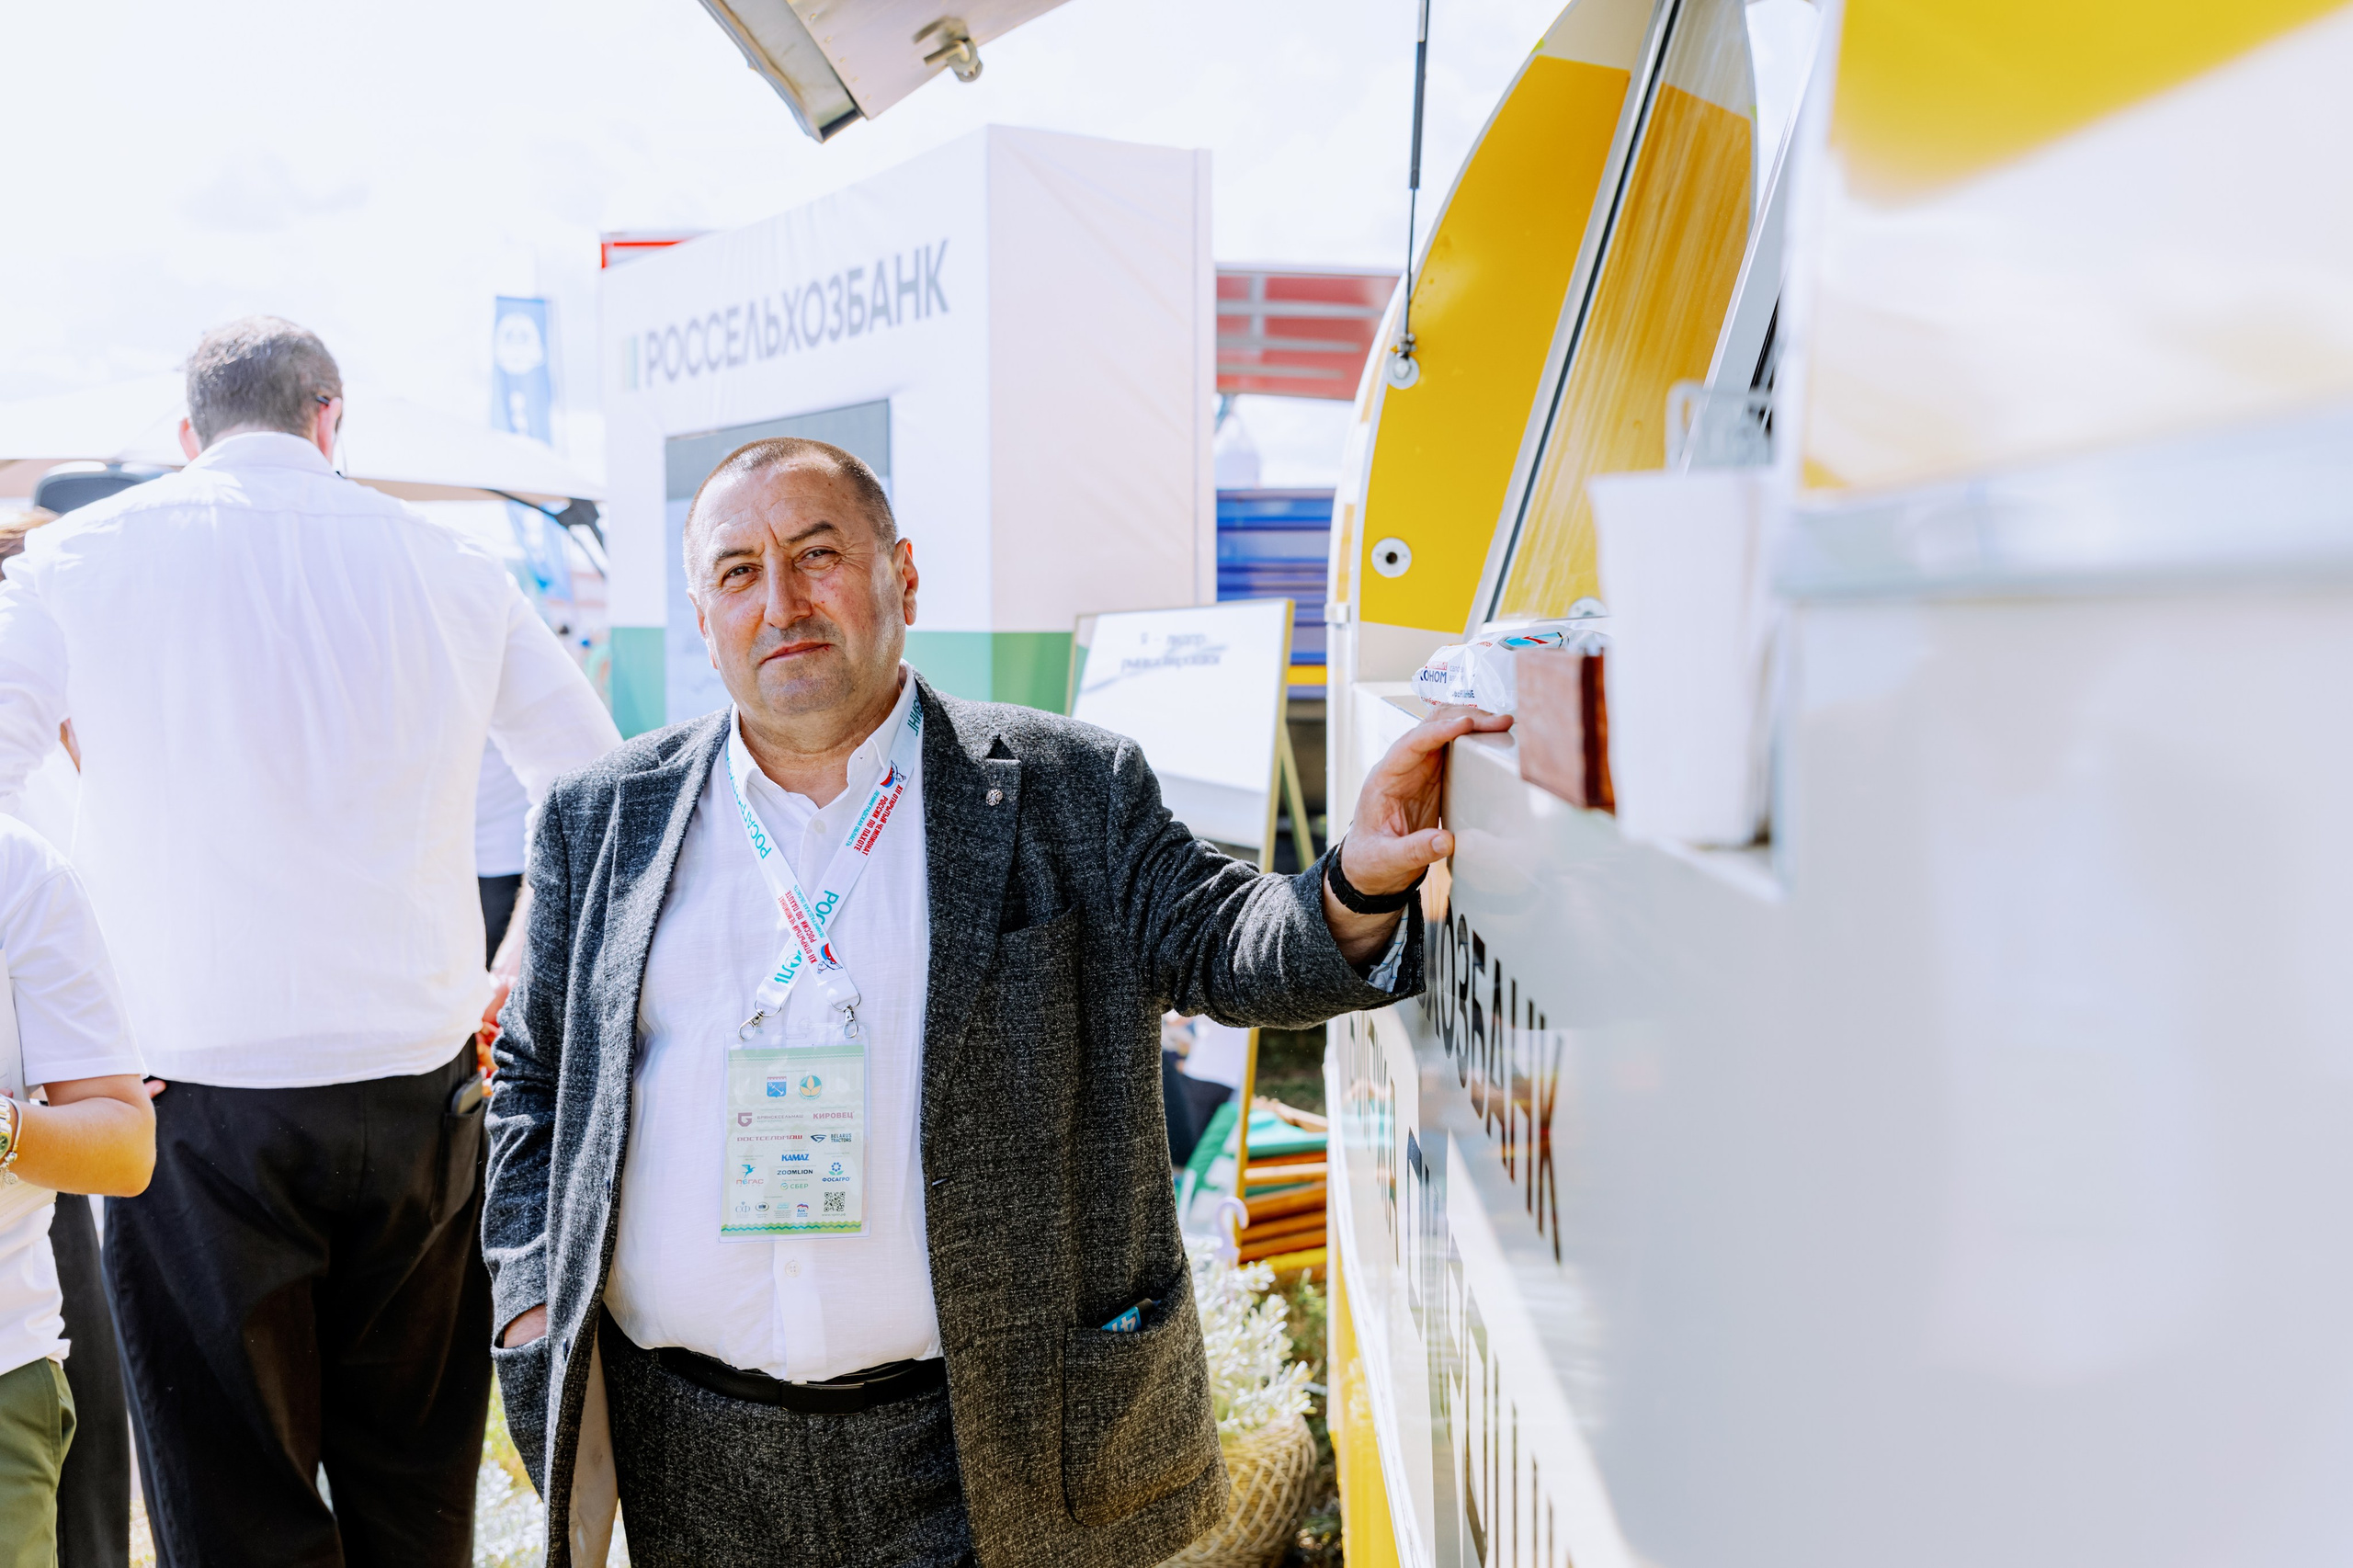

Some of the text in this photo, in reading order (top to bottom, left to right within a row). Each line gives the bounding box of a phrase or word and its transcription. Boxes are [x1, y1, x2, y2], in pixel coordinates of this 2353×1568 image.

[646, 239, 949, 387] РОССЕЛЬХОЗБАНК
[854, 795, 888, 851] РОССИИ ПО ПАХОТЕ
[881, 794, 898, 824] ОТКРЫТЫЙ
[845, 825, 861, 847] ОБЛАСТЬ
[862, 823, 884, 856] ЧЕМПИОНАТ
[785, 890, 817, 943] РОССИИ ПО ПАХОТЕ
[1416, 877, 1565, 1265] ХОЗБАНК
[813, 1111, 853, 1120] КИРОВЕЦ
[781, 1153, 809, 1162] KAMAZ
